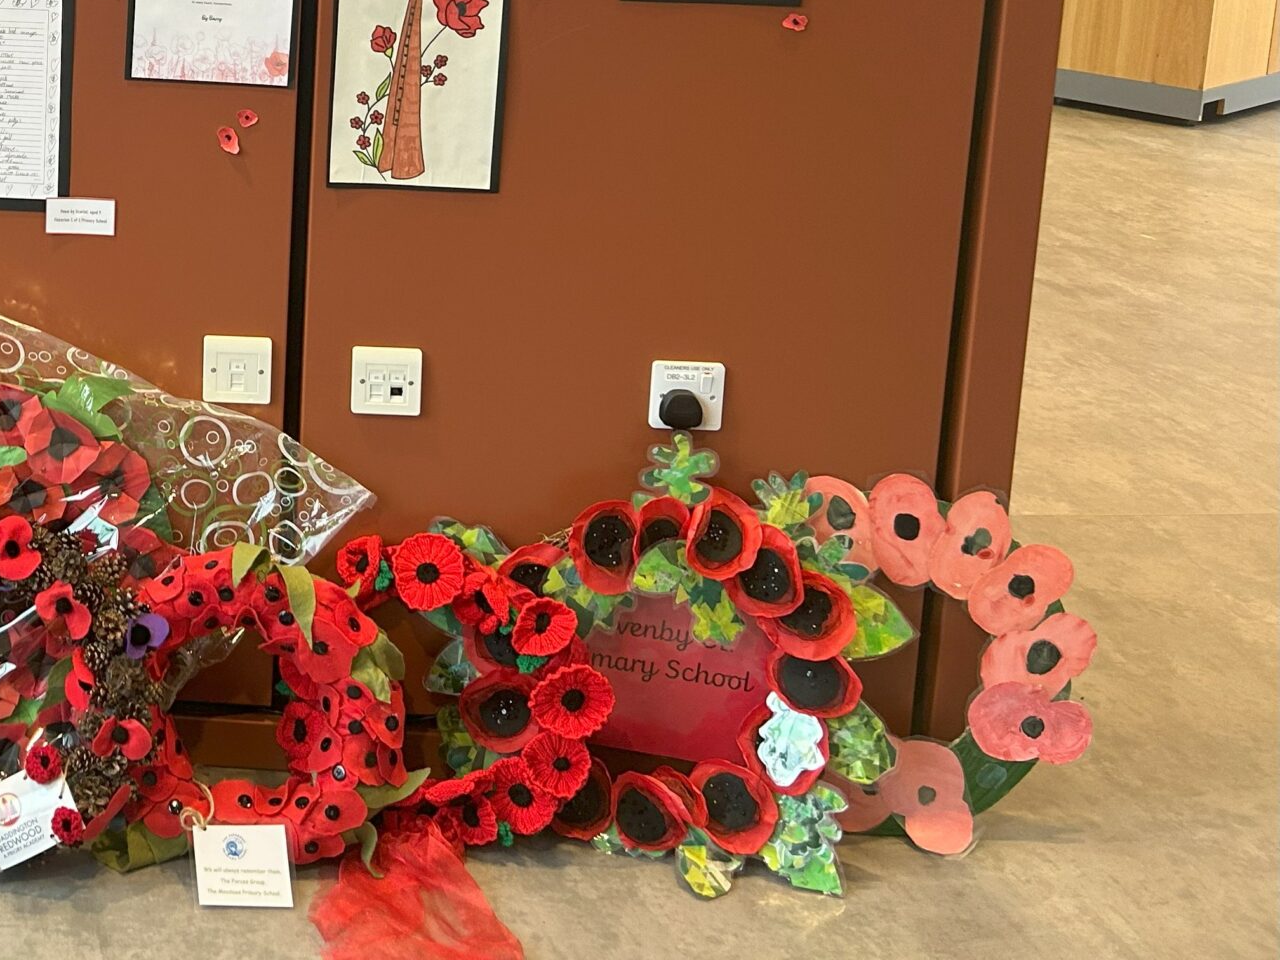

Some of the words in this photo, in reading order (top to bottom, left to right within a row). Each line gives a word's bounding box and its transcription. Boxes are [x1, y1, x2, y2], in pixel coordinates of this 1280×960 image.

[618, 620, 694, 651] venby
[590, 651, 660, 682] mary
[664, 659, 754, 692] School
